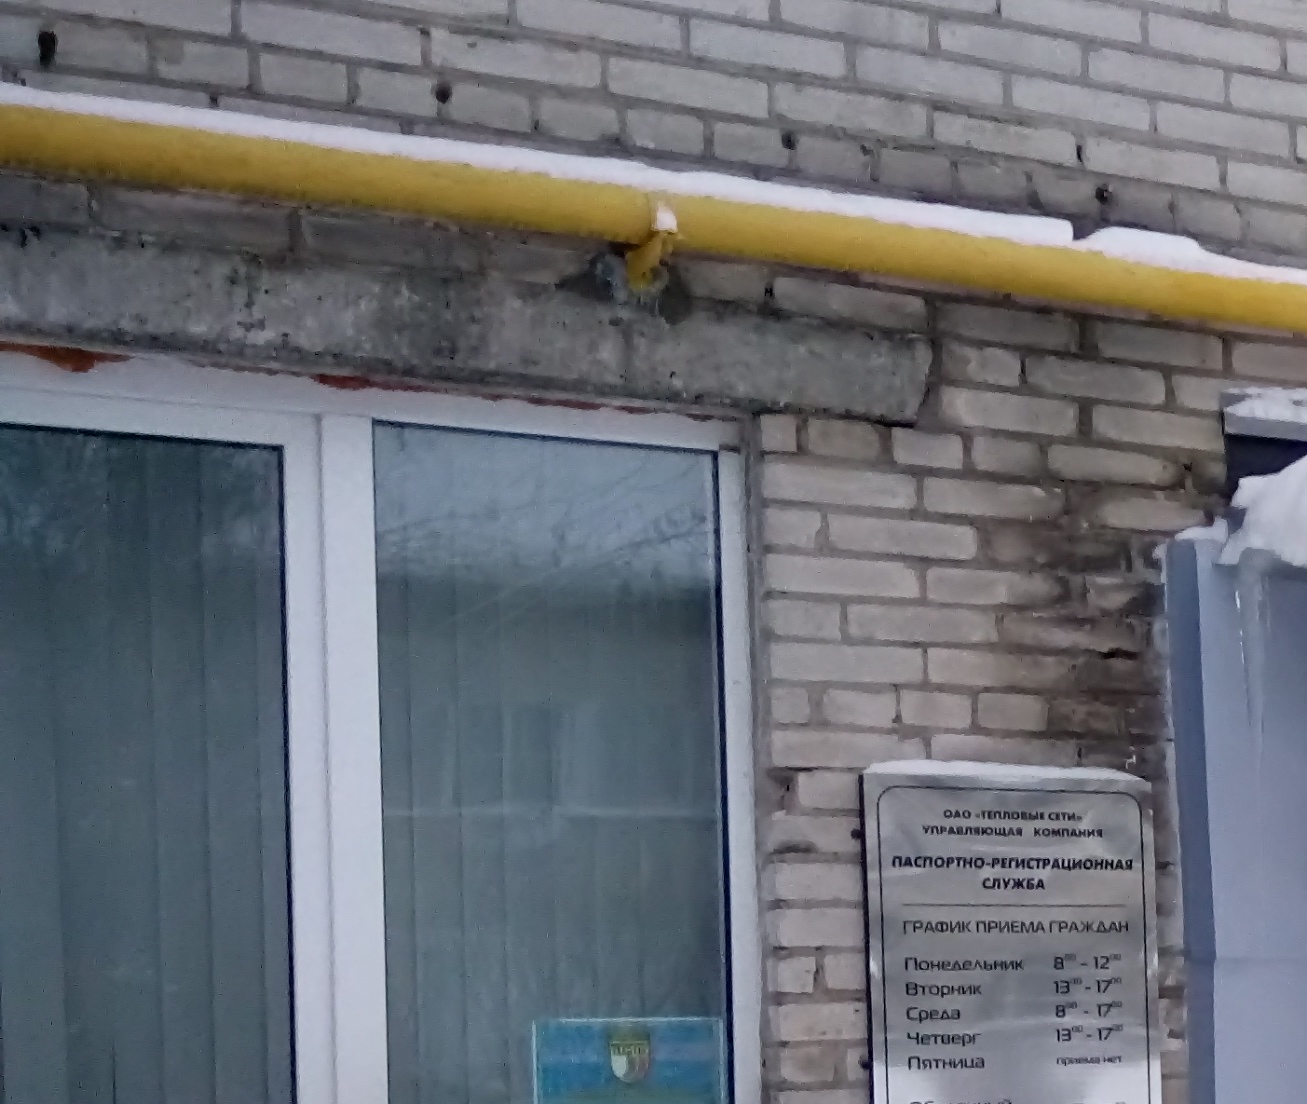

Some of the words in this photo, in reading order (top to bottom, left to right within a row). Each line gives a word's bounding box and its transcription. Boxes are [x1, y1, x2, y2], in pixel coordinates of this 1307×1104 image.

[943, 809, 971, 819] ОАО
[922, 825, 1023, 838] УПРАВЛЯЮЩАЯ
[1033, 827, 1103, 838] КОМПАНИЯ
[892, 856, 1133, 872] ПАСПОРТНО-РЕГИСТРАЦИОННАЯ
[982, 878, 1045, 890] СЛУЖБА
[903, 920, 971, 935] ГРАФИК
[976, 920, 1045, 934] ПРИЕМА
[1049, 920, 1129, 934] ГРАЖДАН
[904, 957, 1024, 972] Понедельник
[905, 982, 982, 998] Вторник
[906, 1006, 961, 1024] Среда
[907, 1032, 982, 1047] Четверг
[908, 1055, 985, 1070] Пятница
